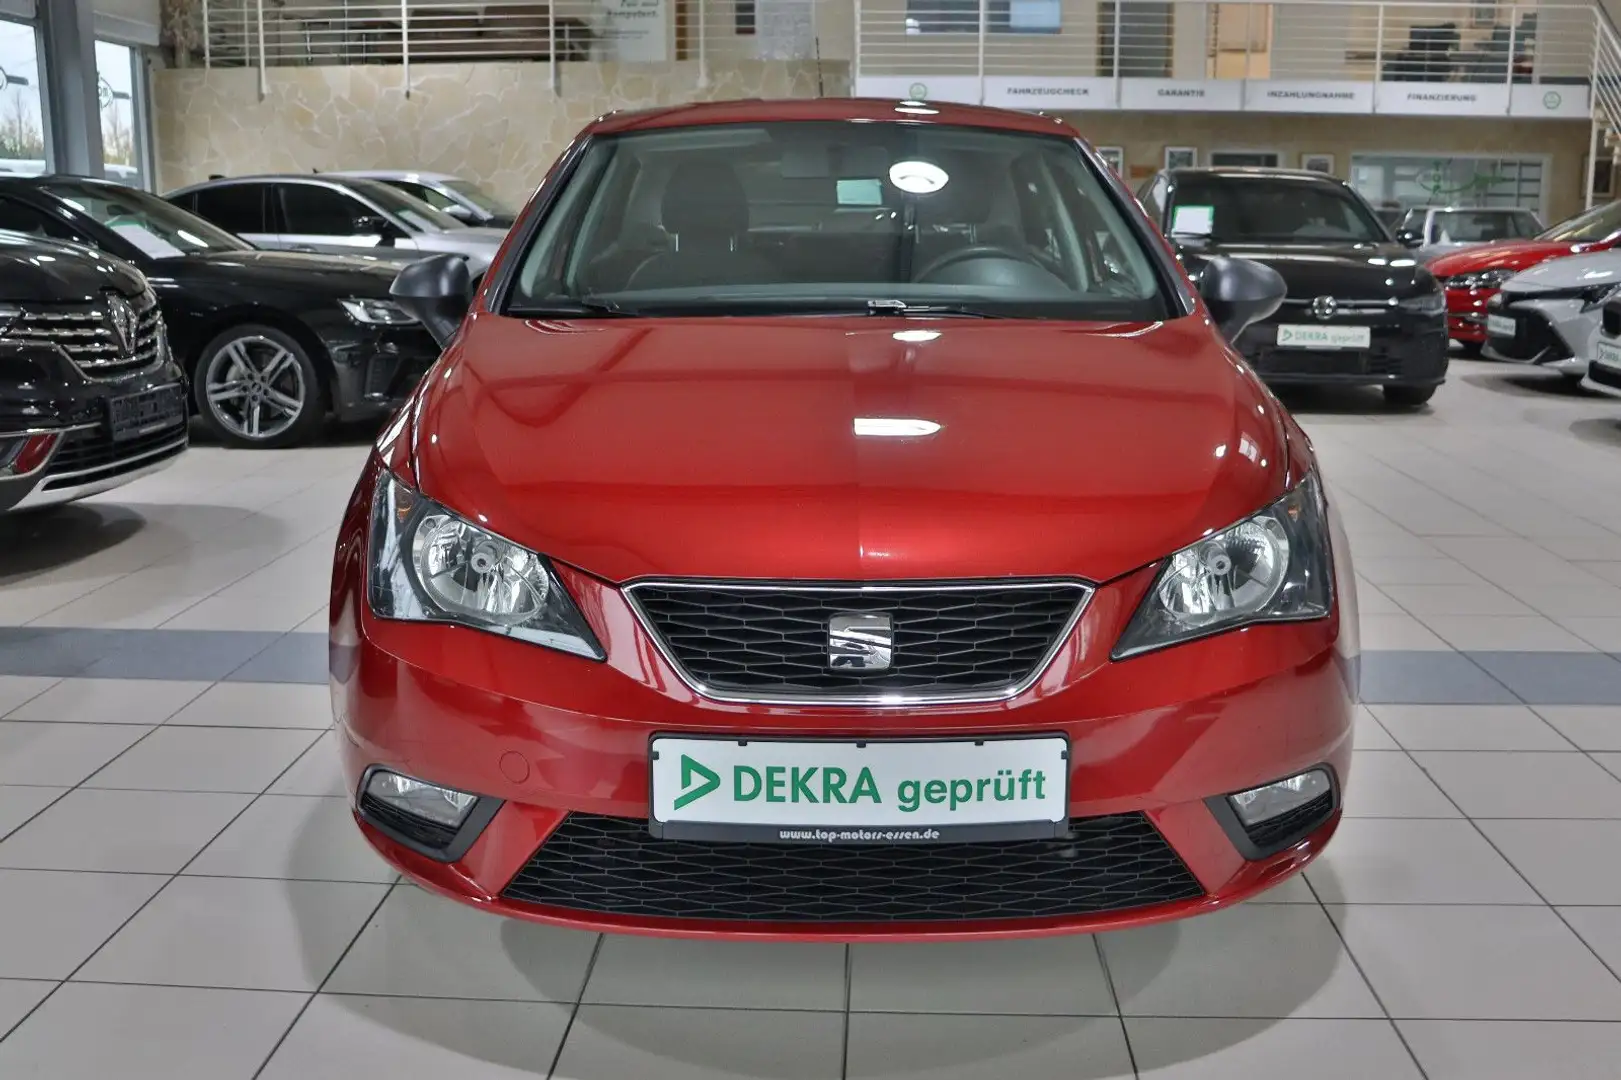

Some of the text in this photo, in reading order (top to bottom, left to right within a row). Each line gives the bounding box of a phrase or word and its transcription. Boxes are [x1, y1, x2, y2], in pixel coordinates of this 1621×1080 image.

[1007, 87, 1089, 96] FAHRZEUGCHECK
[1157, 89, 1205, 97] GARANTIE
[1267, 90, 1355, 100] INZAHLUNGNAHME
[1407, 92, 1477, 102] FINANZIERUNG
[733, 765, 1046, 812] DEKRA geprüft
[779, 828, 940, 843] www.top-motors-essen.de
